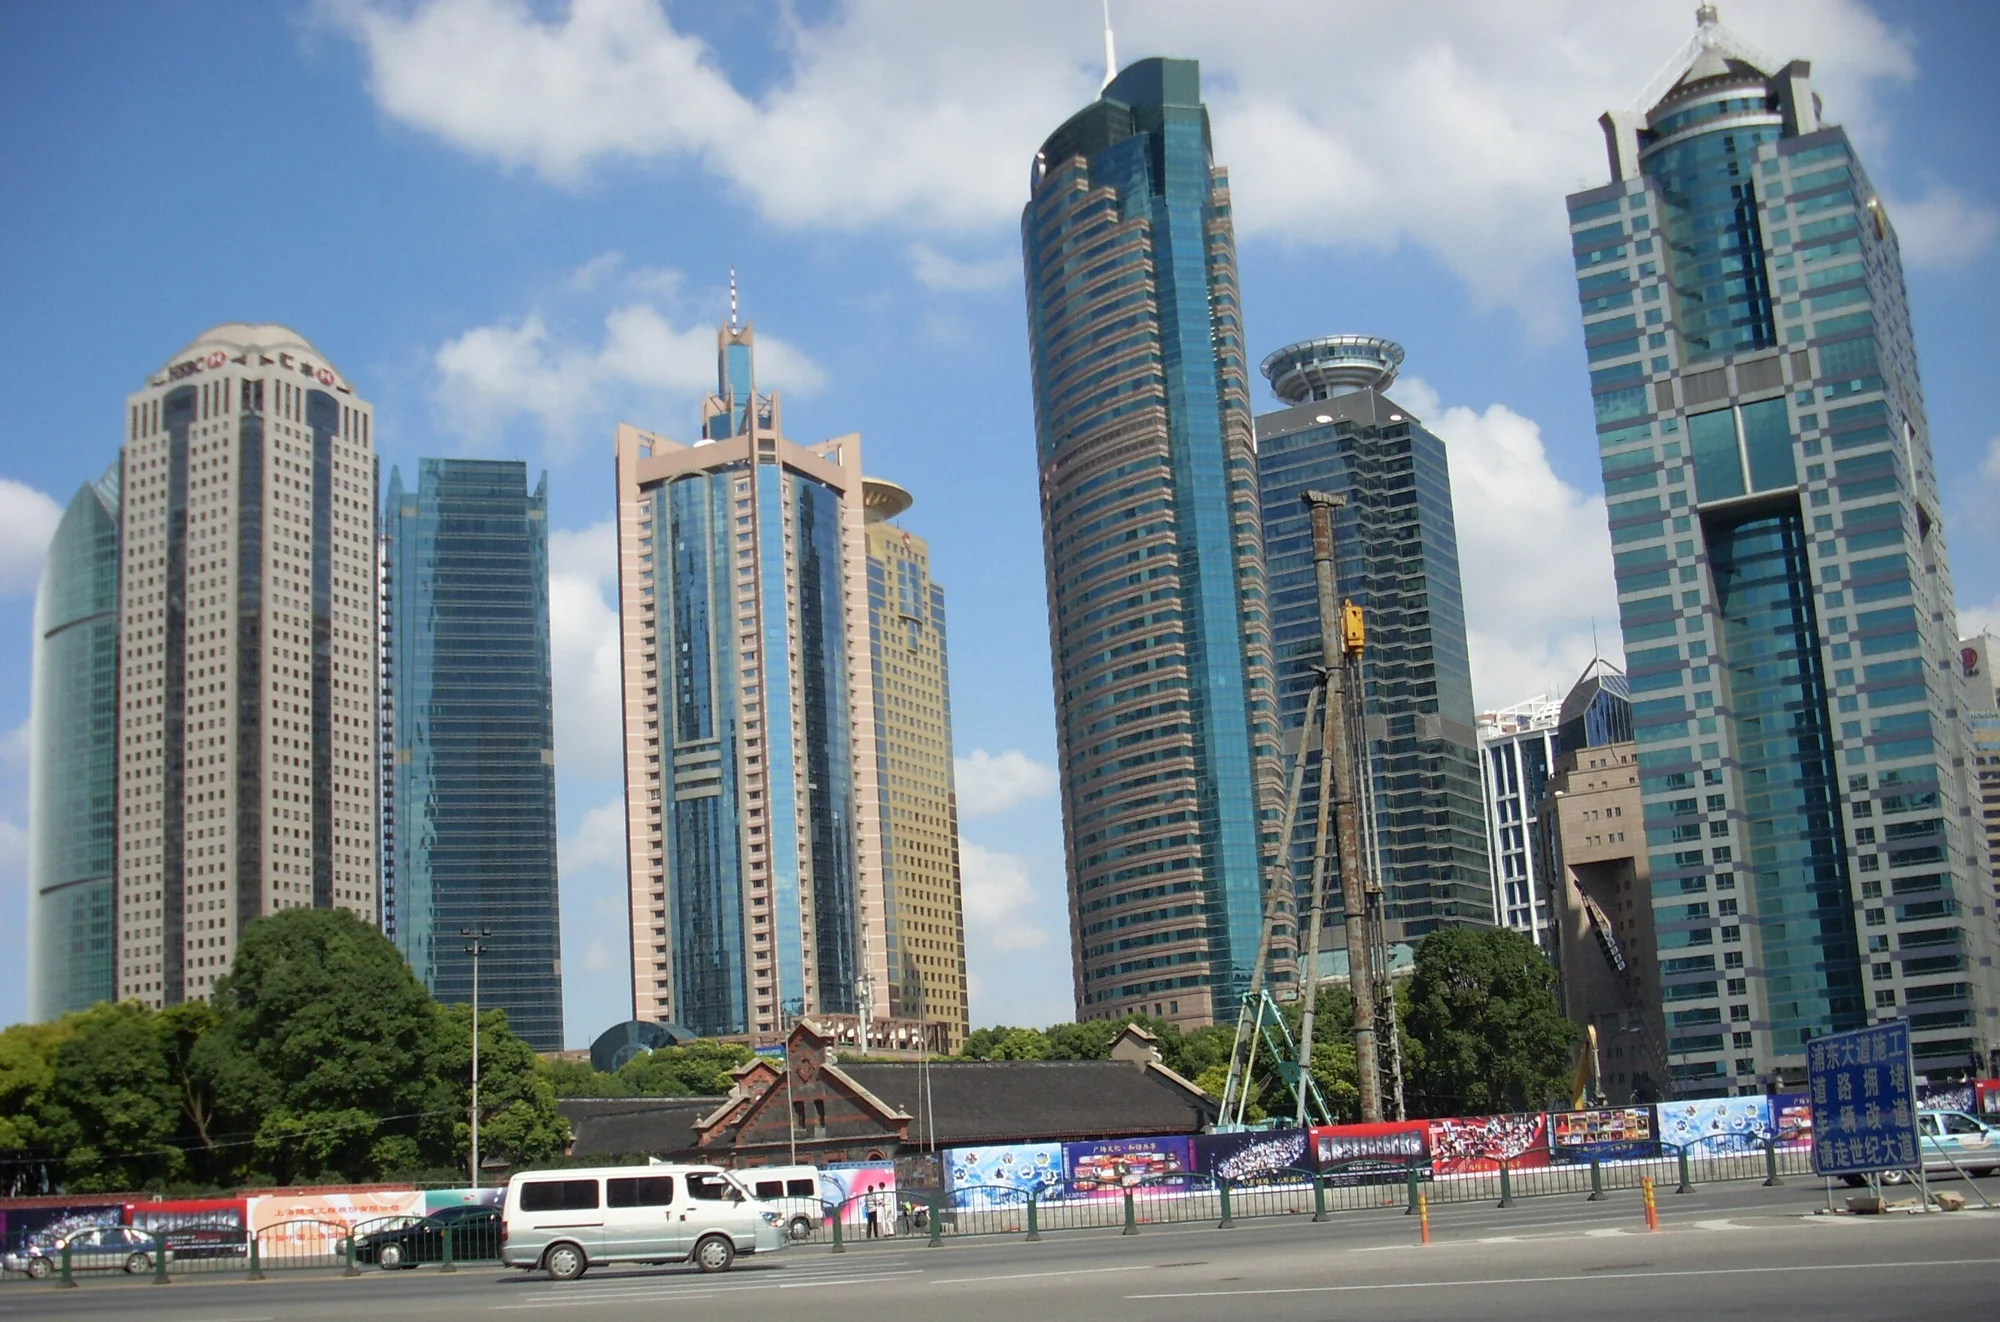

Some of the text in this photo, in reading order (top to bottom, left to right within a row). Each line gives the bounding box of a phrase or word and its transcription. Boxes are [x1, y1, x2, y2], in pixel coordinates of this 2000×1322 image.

[1811, 1030, 1904, 1072] 浦东大道施工
[1813, 1063, 1906, 1105] 道路拥堵
[1815, 1099, 1911, 1136] 车辆改道
[1819, 1132, 1915, 1169] 请走世纪大道
